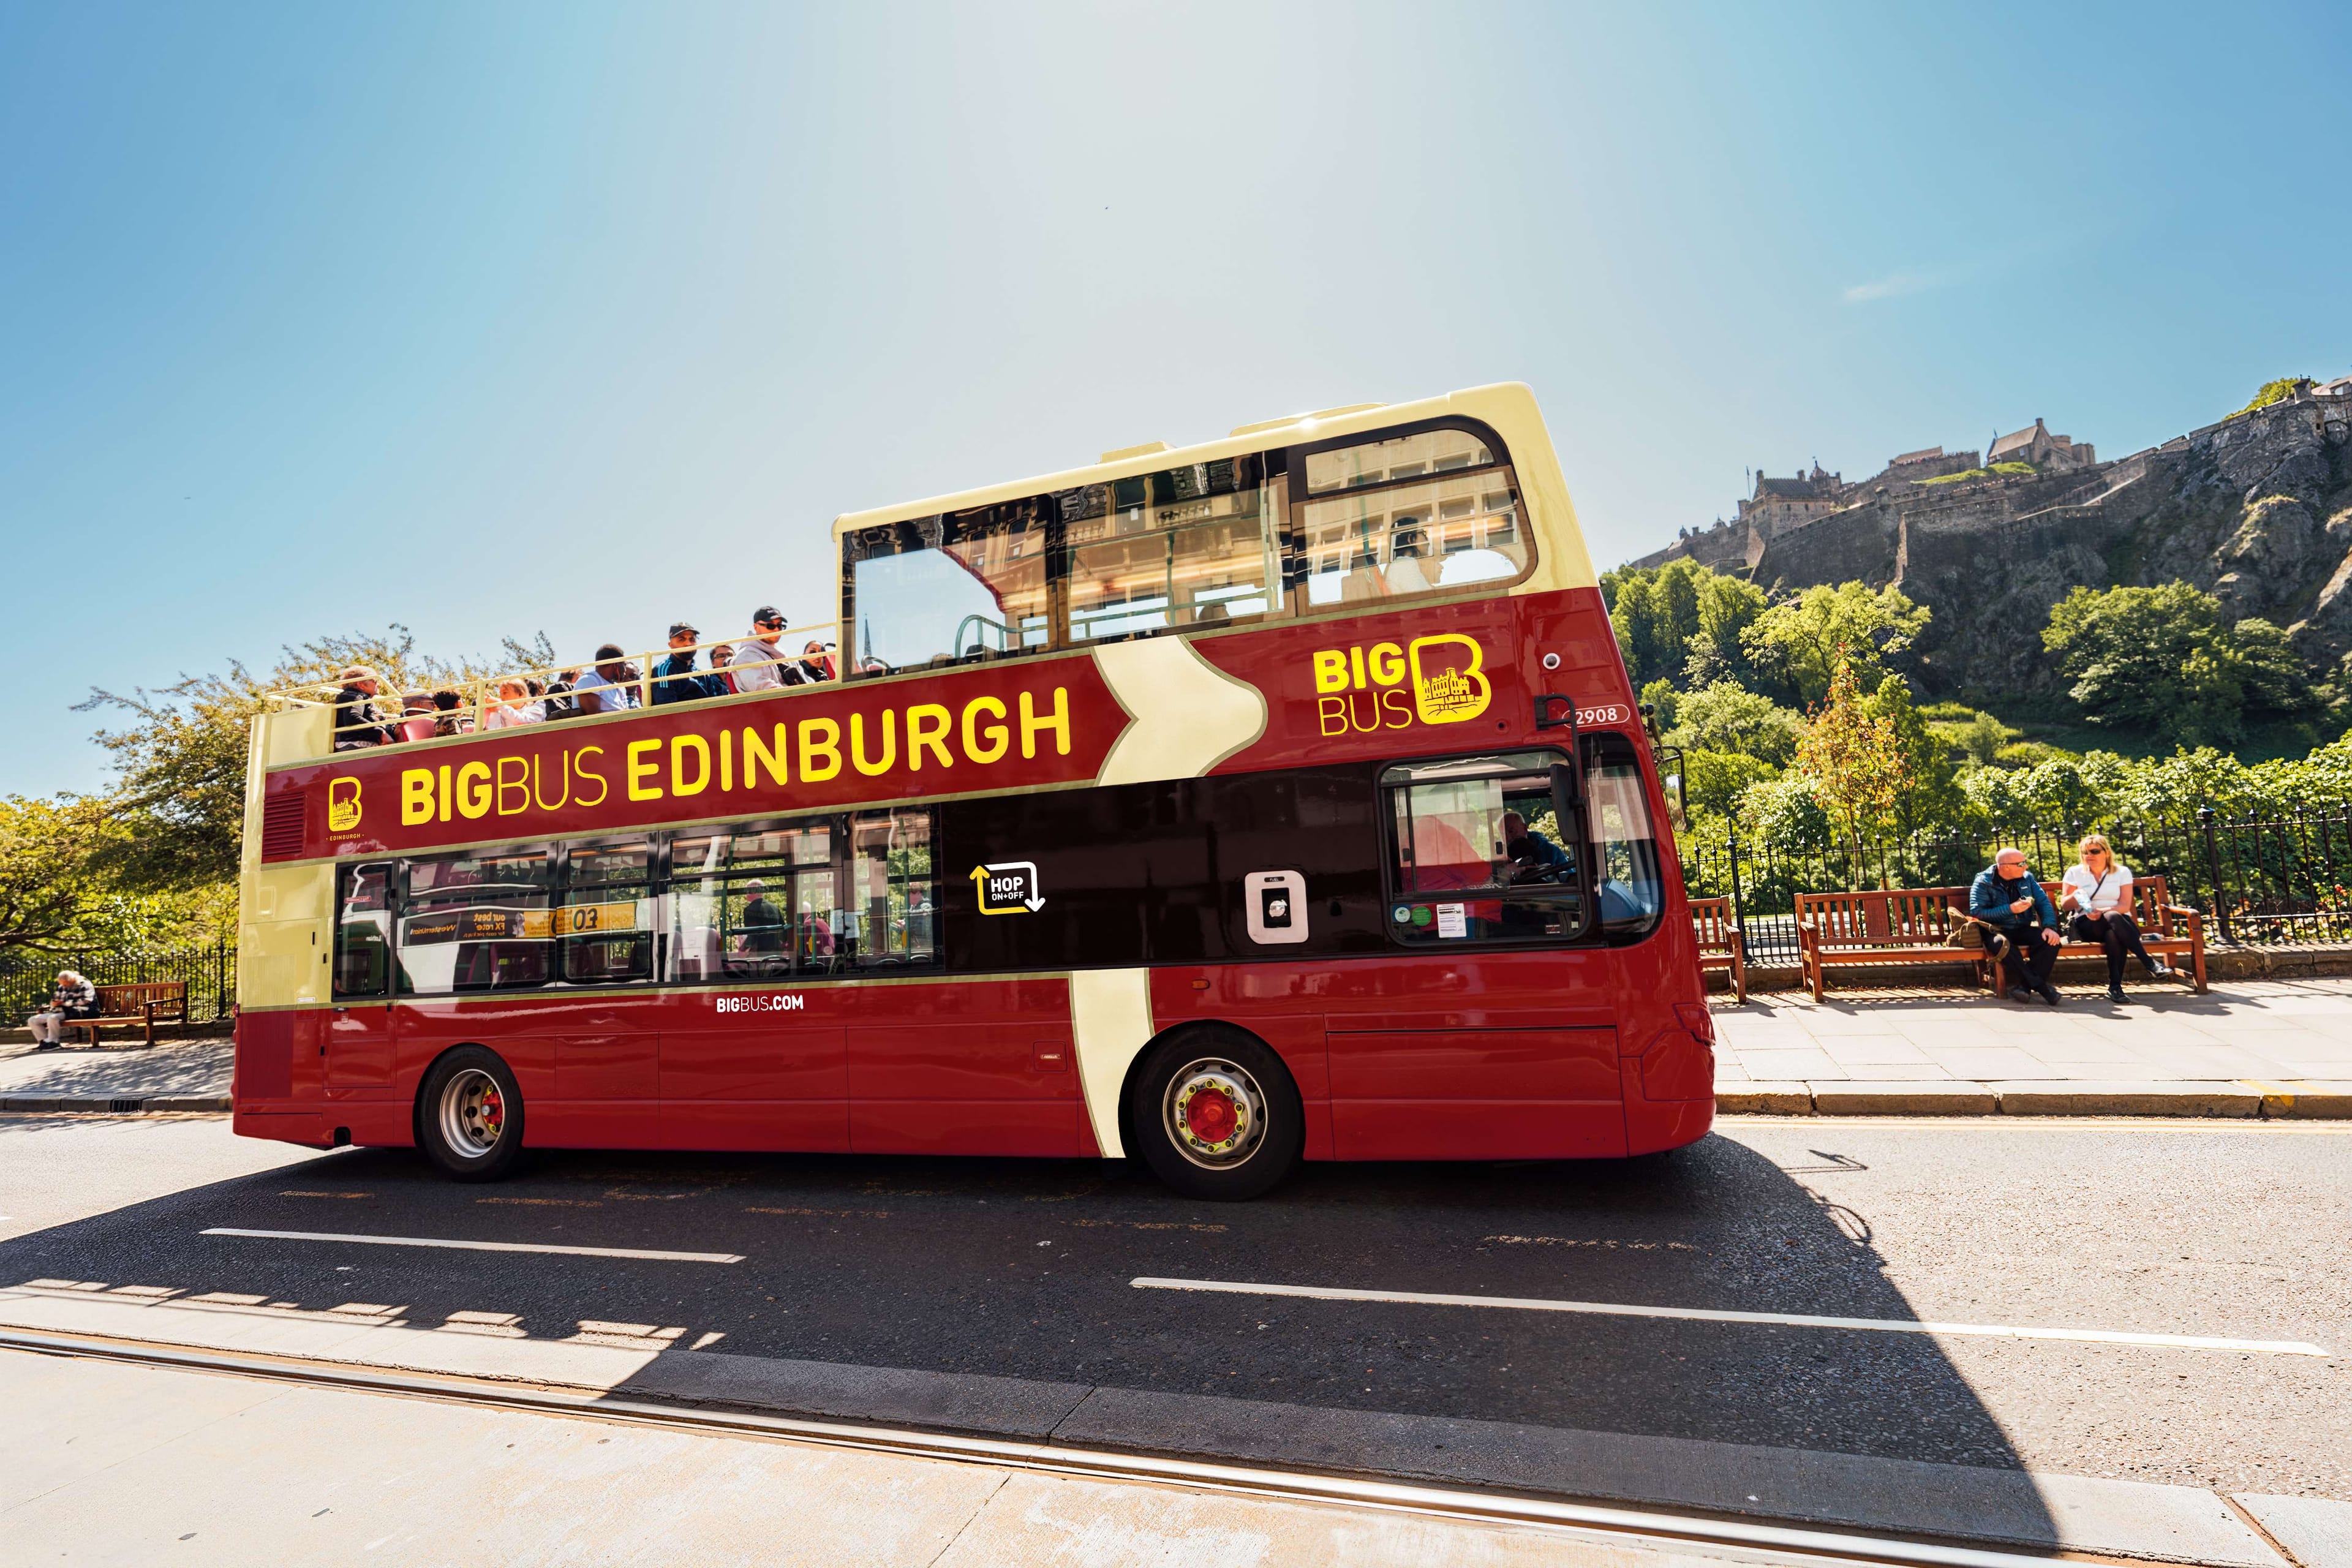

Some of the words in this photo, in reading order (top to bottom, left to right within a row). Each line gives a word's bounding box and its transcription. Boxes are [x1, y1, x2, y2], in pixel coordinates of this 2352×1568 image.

[1313, 642, 1406, 694] BIG
[1318, 689, 1412, 736] BUS
[1575, 707, 1618, 725] 2908
[627, 687, 1071, 802] EDINBURGH
[990, 876, 1023, 892] HOP
[717, 995, 804, 1013] BIGBUS.COM
